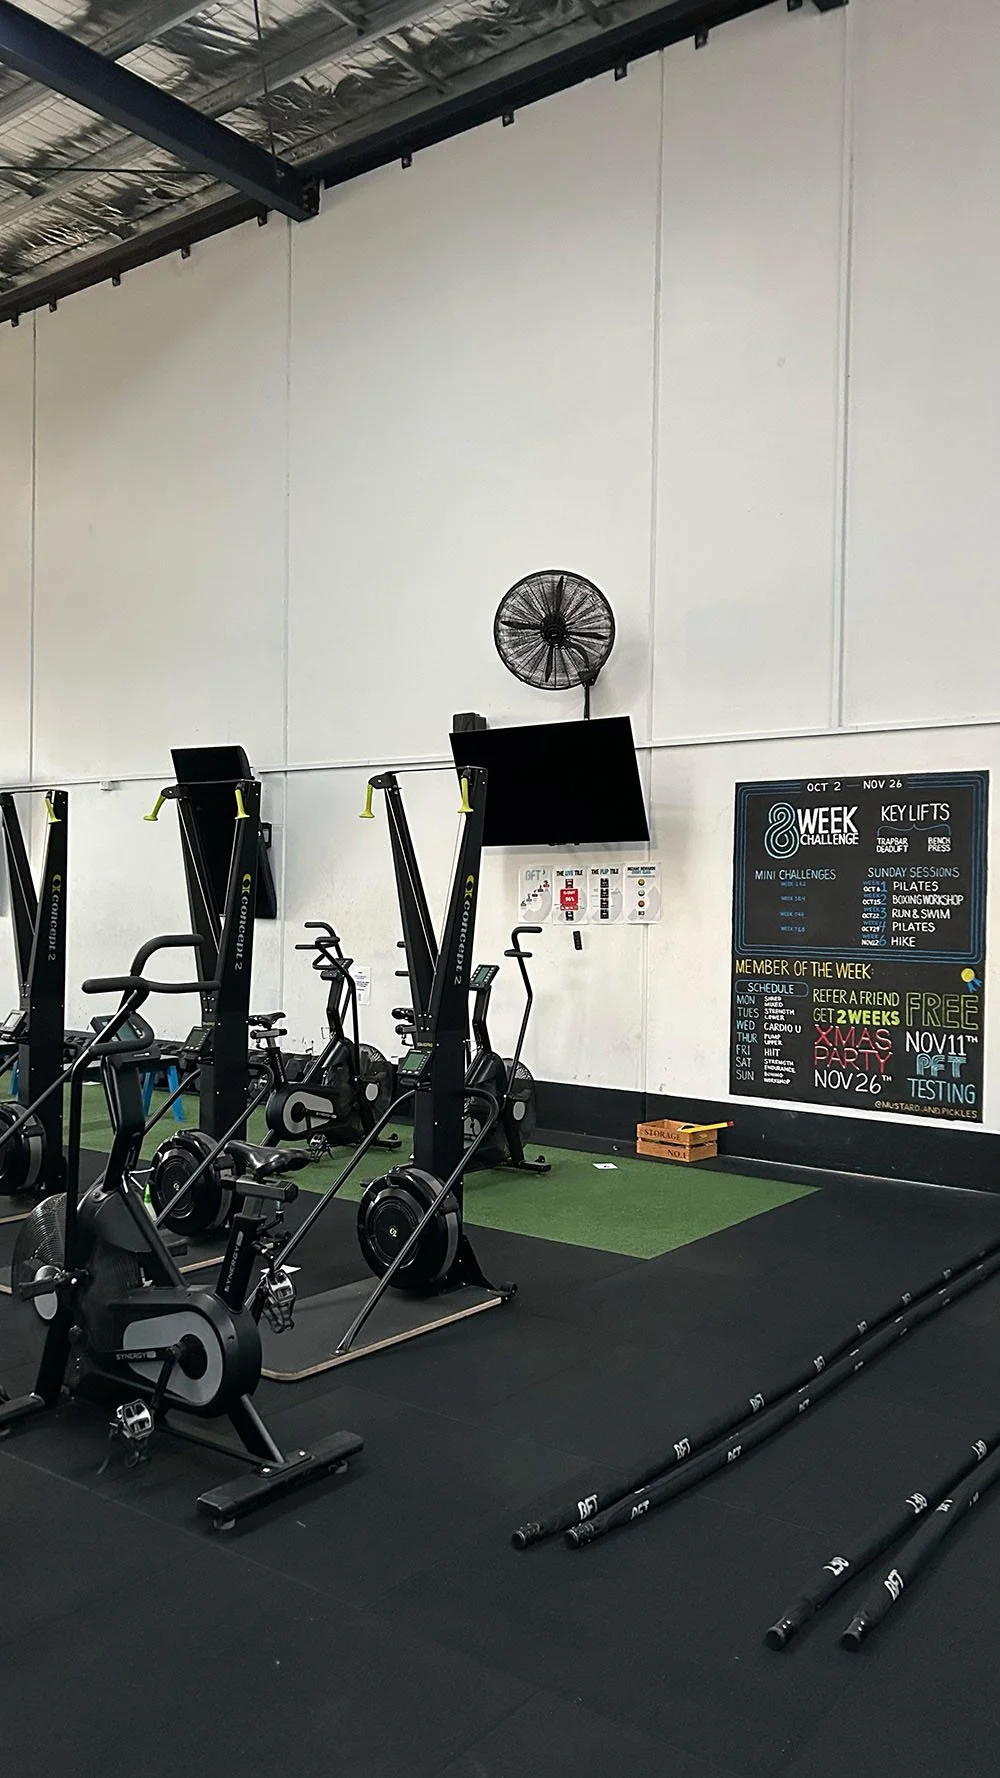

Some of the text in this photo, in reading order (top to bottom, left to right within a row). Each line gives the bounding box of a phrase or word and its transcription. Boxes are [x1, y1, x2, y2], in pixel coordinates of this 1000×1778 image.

[807, 780, 902, 791] OCT 2 NOV 26
[882, 803, 950, 821] KEY LIFTS
[798, 806, 858, 833] WEEK
[800, 833, 859, 845] CHALLENGE
[928, 837, 951, 845] BENCH
[877, 845, 908, 853] DEADLIFT
[755, 869, 836, 880] MINI CHALLENGES
[868, 867, 959, 878] SUNDAY SESSIONS
[893, 882, 939, 892] PILATES
[892, 895, 963, 906] BOXING WORKSHOP
[892, 909, 950, 920] RUN & SWIM
[892, 922, 935, 932] PILATES
[234, 896, 248, 970] concept 2
[454, 900, 470, 985] concept 2
[891, 937, 915, 947] HIKE
[48, 953, 56, 961] 2
[736, 960, 789, 976] MEMBER
[794, 961, 808, 977] OF
[811, 962, 833, 978] THE
[748, 982, 794, 994] SCHEDULE
[737, 995, 755, 1006] MON
[813, 989, 899, 1007] REFER A FRIEND
[737, 1007, 759, 1018] TUES
[906, 992, 979, 1030] FREE
[813, 1008, 900, 1026] GET 2 WEEKS
[736, 1020, 755, 1031] WED
[764, 1022, 802, 1034] CARDIO U
[737, 1032, 758, 1044] THUR
[814, 1024, 892, 1050] XMAS
[905, 1031, 946, 1053] NOV
[736, 1045, 751, 1055] FRI
[764, 1048, 781, 1057] HIIT
[736, 1057, 751, 1068] SAT
[764, 1058, 794, 1066] STRENGTH
[814, 1046, 893, 1074] PARTY
[736, 1070, 754, 1081] SUN
[814, 1069, 852, 1090] NOV
[907, 1078, 976, 1104] TESTING
[644, 1130, 680, 1141] STORAGE
[667, 1150, 686, 1159] NO.1
[116, 1351, 147, 1360] SYNERGY
[577, 1493, 598, 1520] BFT
